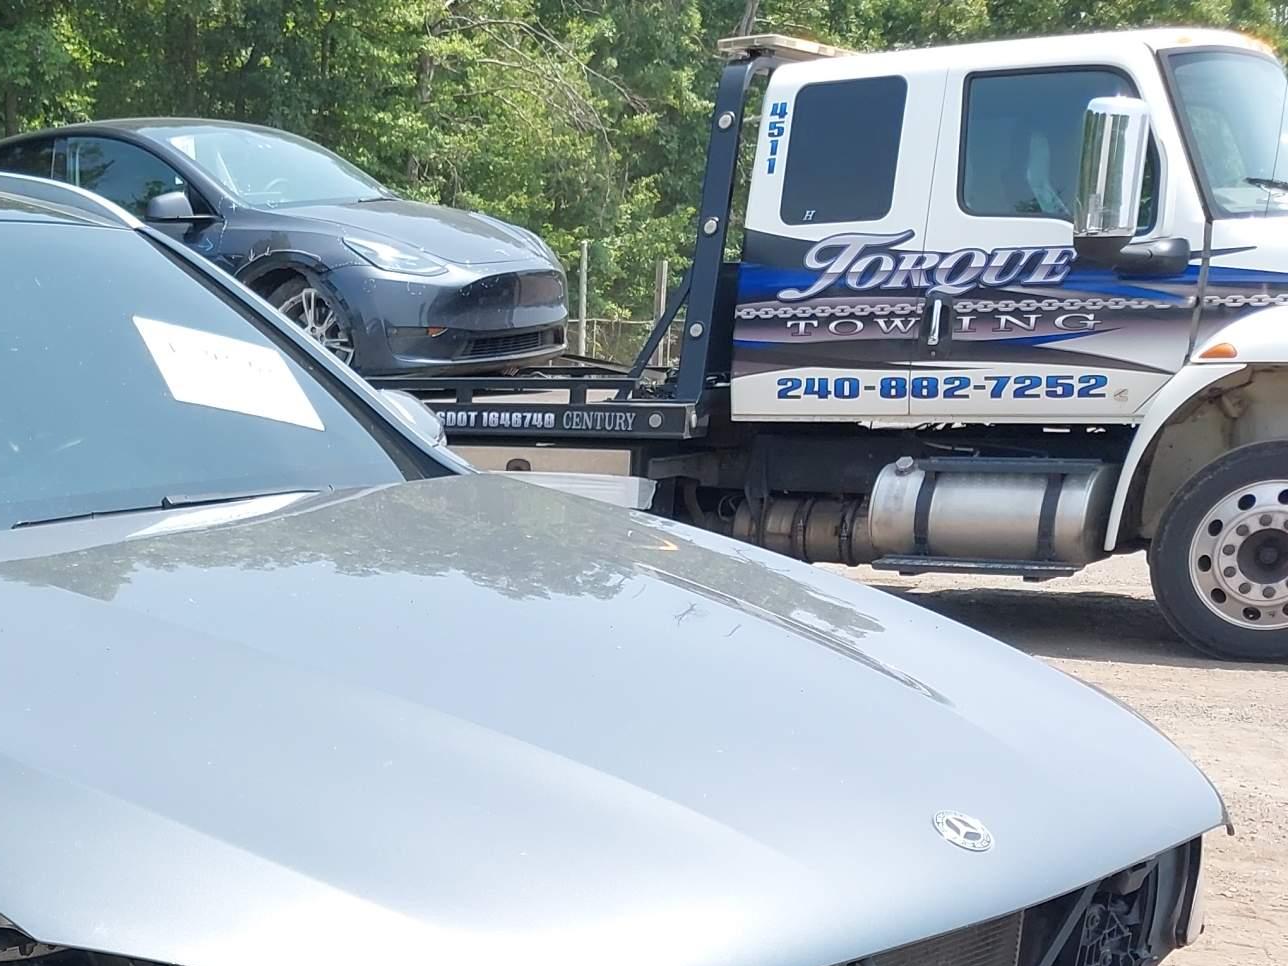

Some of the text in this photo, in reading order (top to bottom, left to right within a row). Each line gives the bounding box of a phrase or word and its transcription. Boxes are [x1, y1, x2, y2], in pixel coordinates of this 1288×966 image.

[767, 101, 789, 175] 4511
[785, 313, 1103, 338] TOWING
[775, 373, 1109, 400] 240-882-7252
[563, 410, 636, 431] CENTURY
